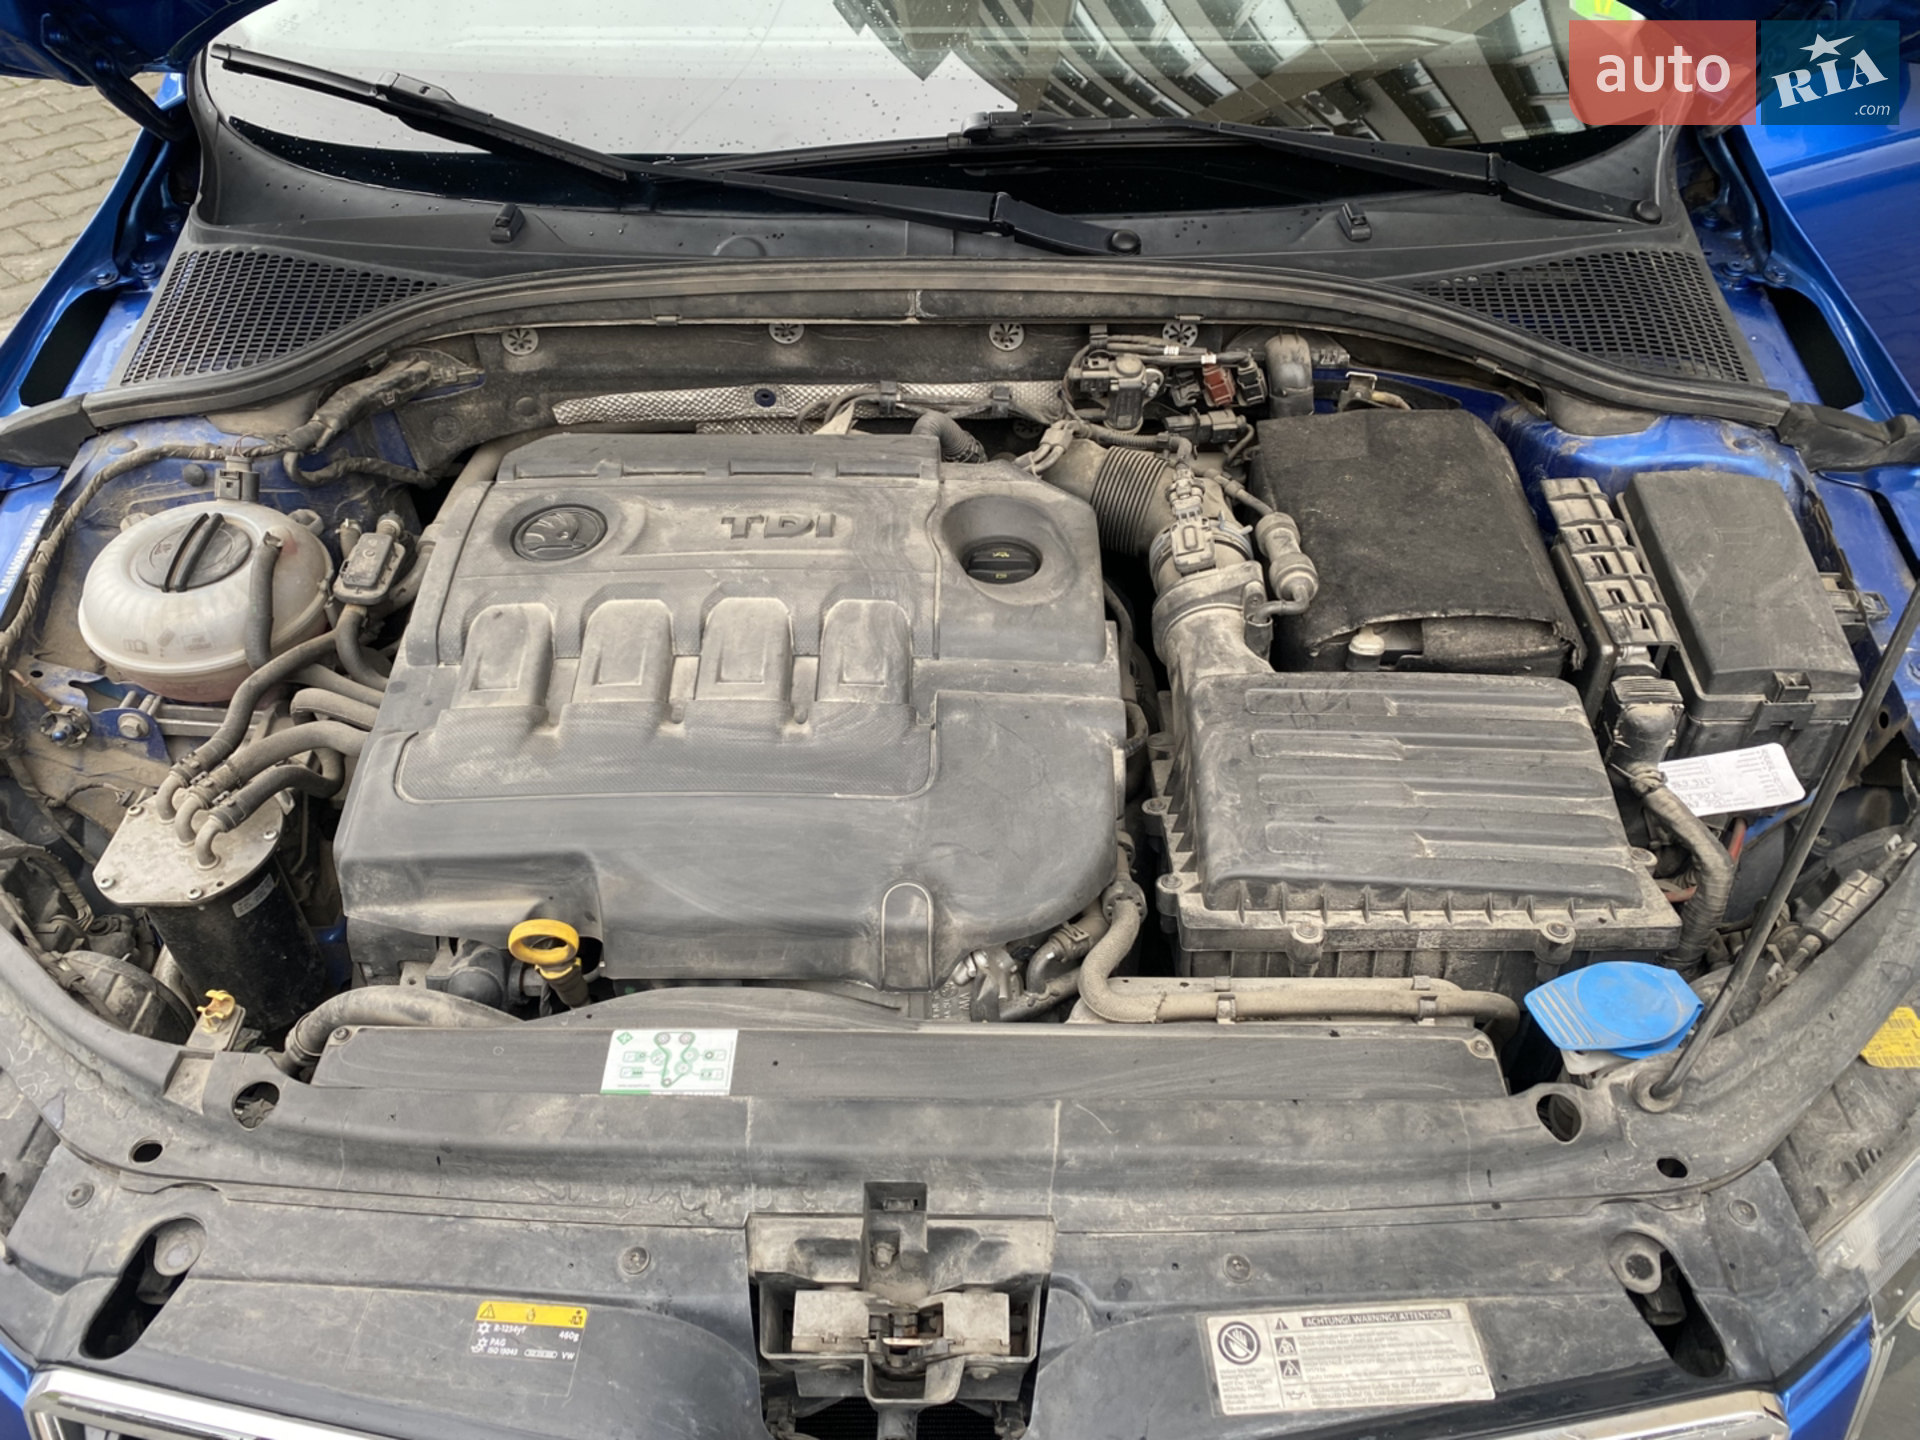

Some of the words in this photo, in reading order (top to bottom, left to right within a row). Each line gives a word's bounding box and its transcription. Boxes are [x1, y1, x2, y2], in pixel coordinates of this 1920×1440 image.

[720, 513, 837, 540] TDI
[1305, 1315, 1351, 1327] ACHTUNG!
[1353, 1312, 1399, 1324] WARNING!
[1400, 1310, 1450, 1322] ATTENTION!
[562, 1351, 575, 1360] VW
